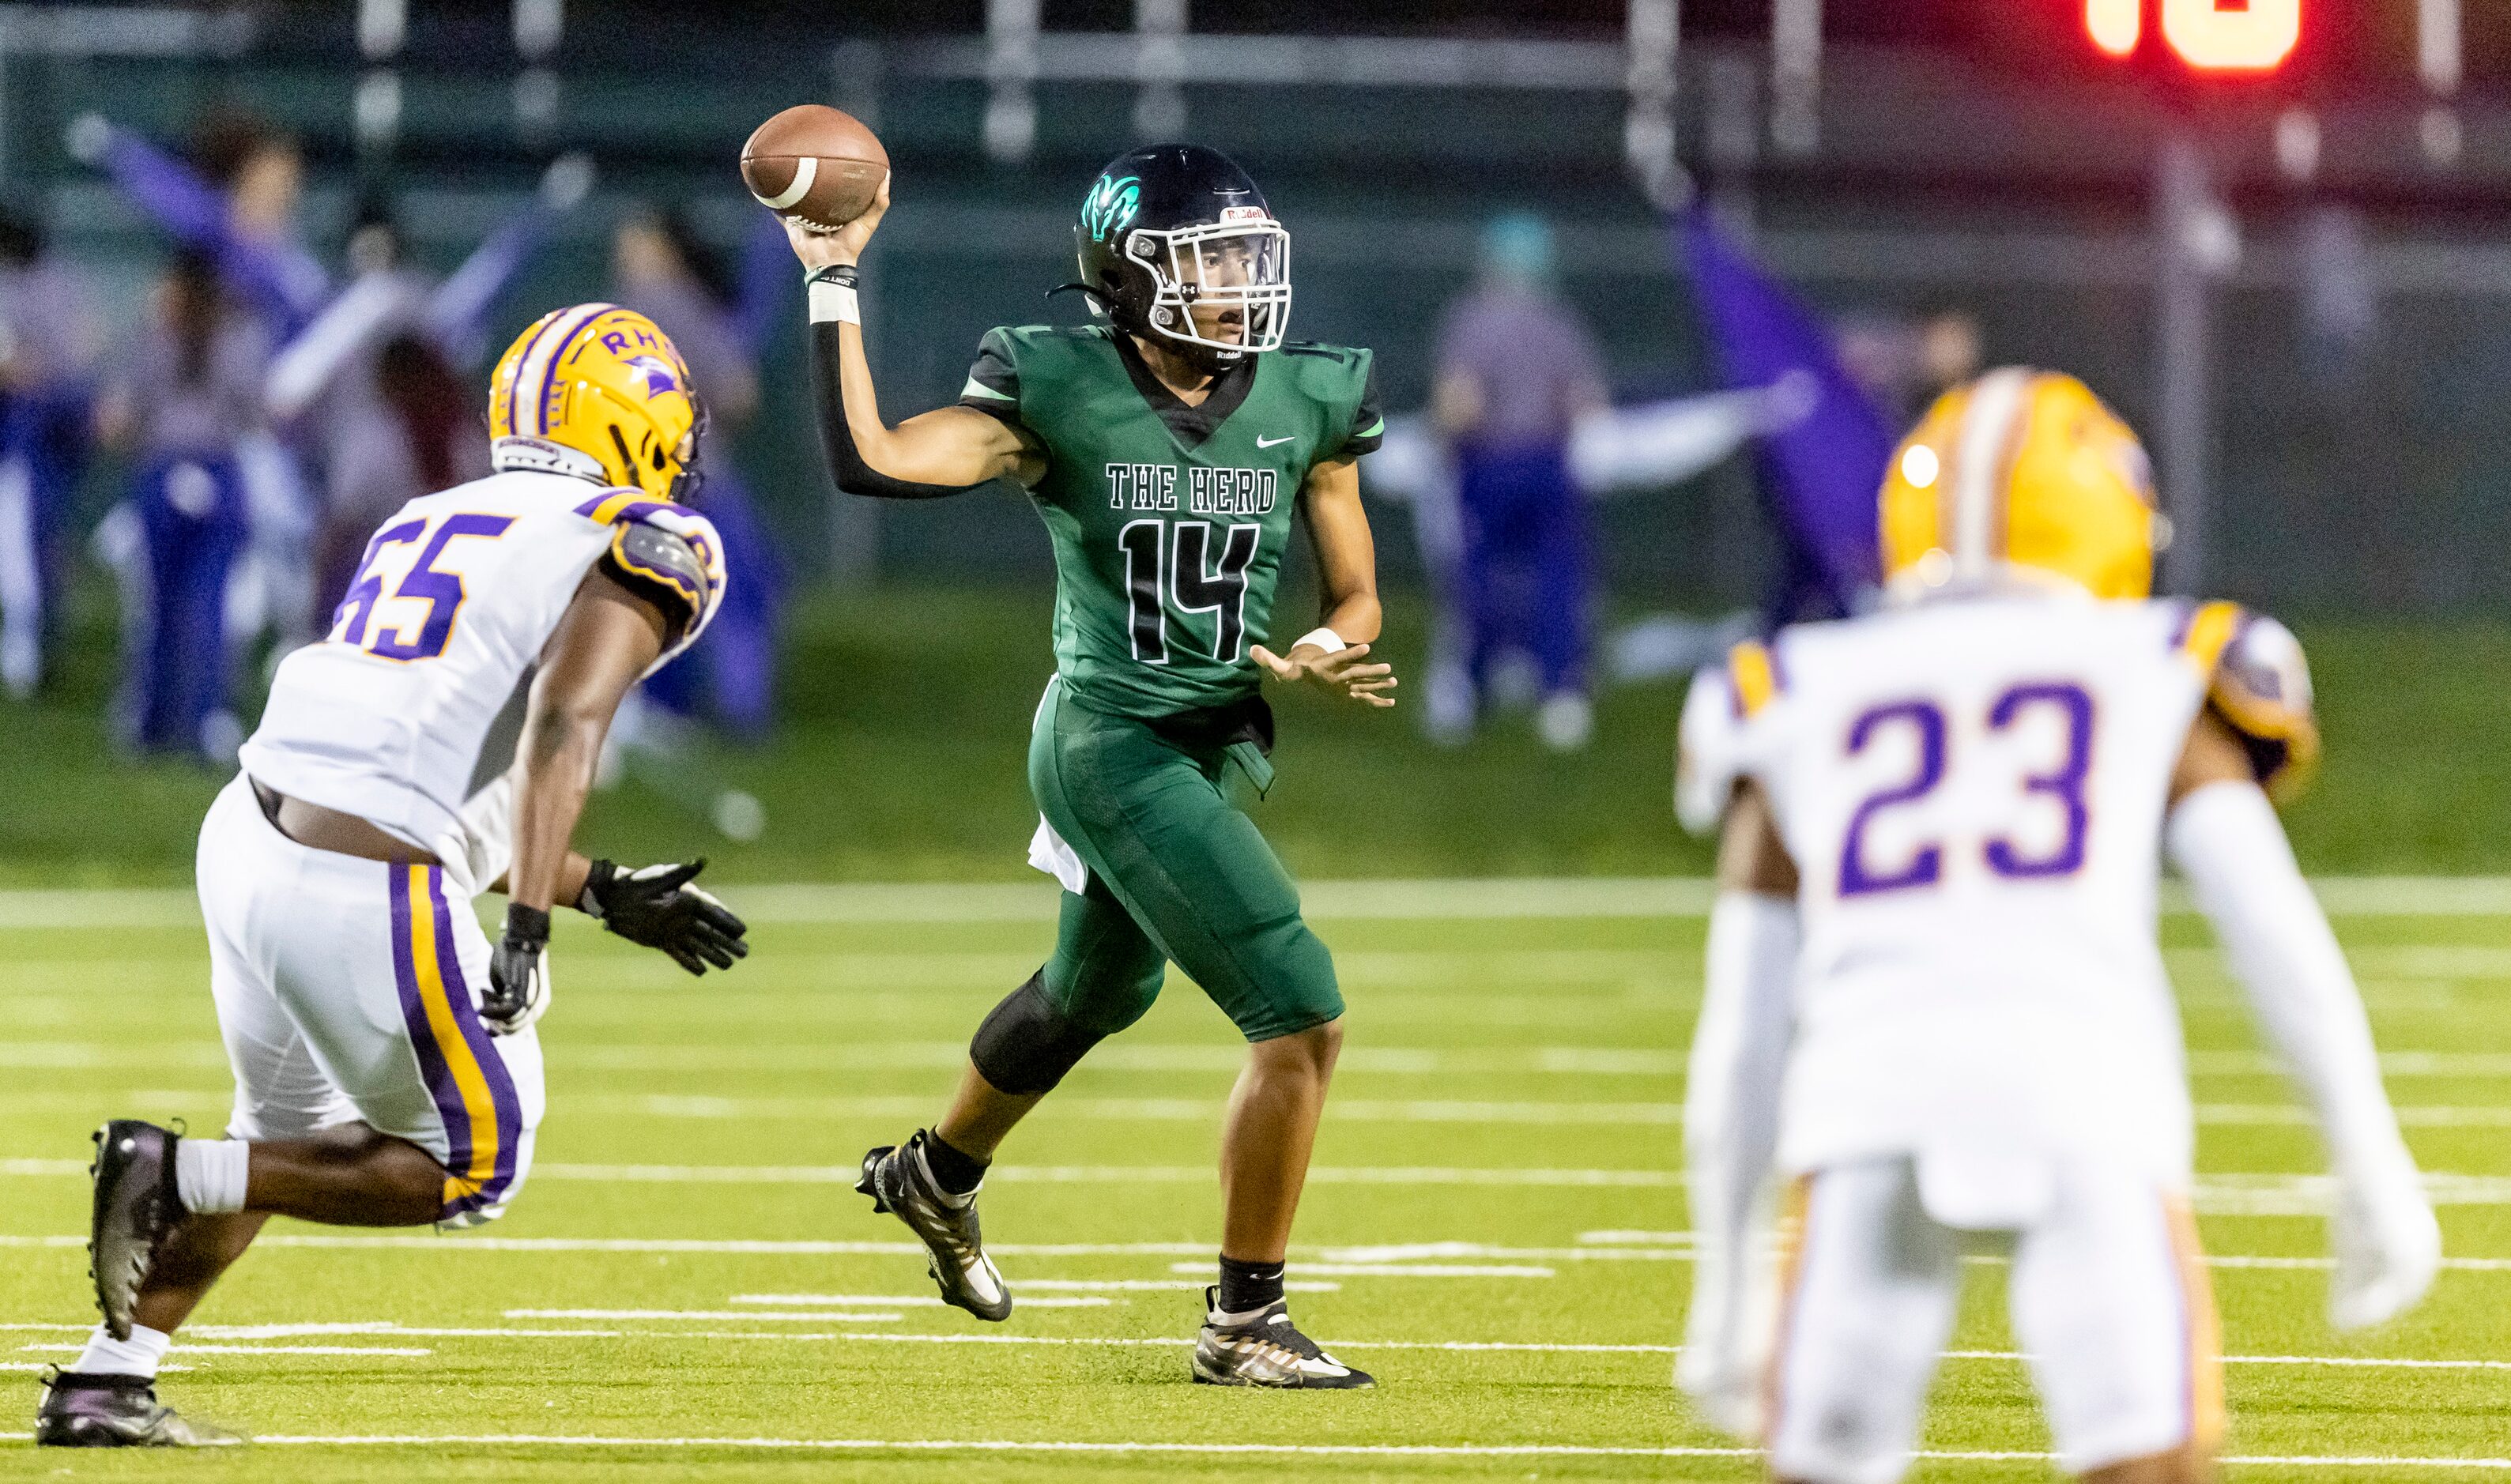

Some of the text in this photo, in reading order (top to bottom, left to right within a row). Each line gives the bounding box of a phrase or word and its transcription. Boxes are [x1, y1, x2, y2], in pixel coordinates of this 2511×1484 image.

[600, 328, 678, 356] RH
[1106, 463, 1277, 514] THE HERD
[1118, 519, 1261, 665] 14
[1838, 684, 2094, 897] 23
